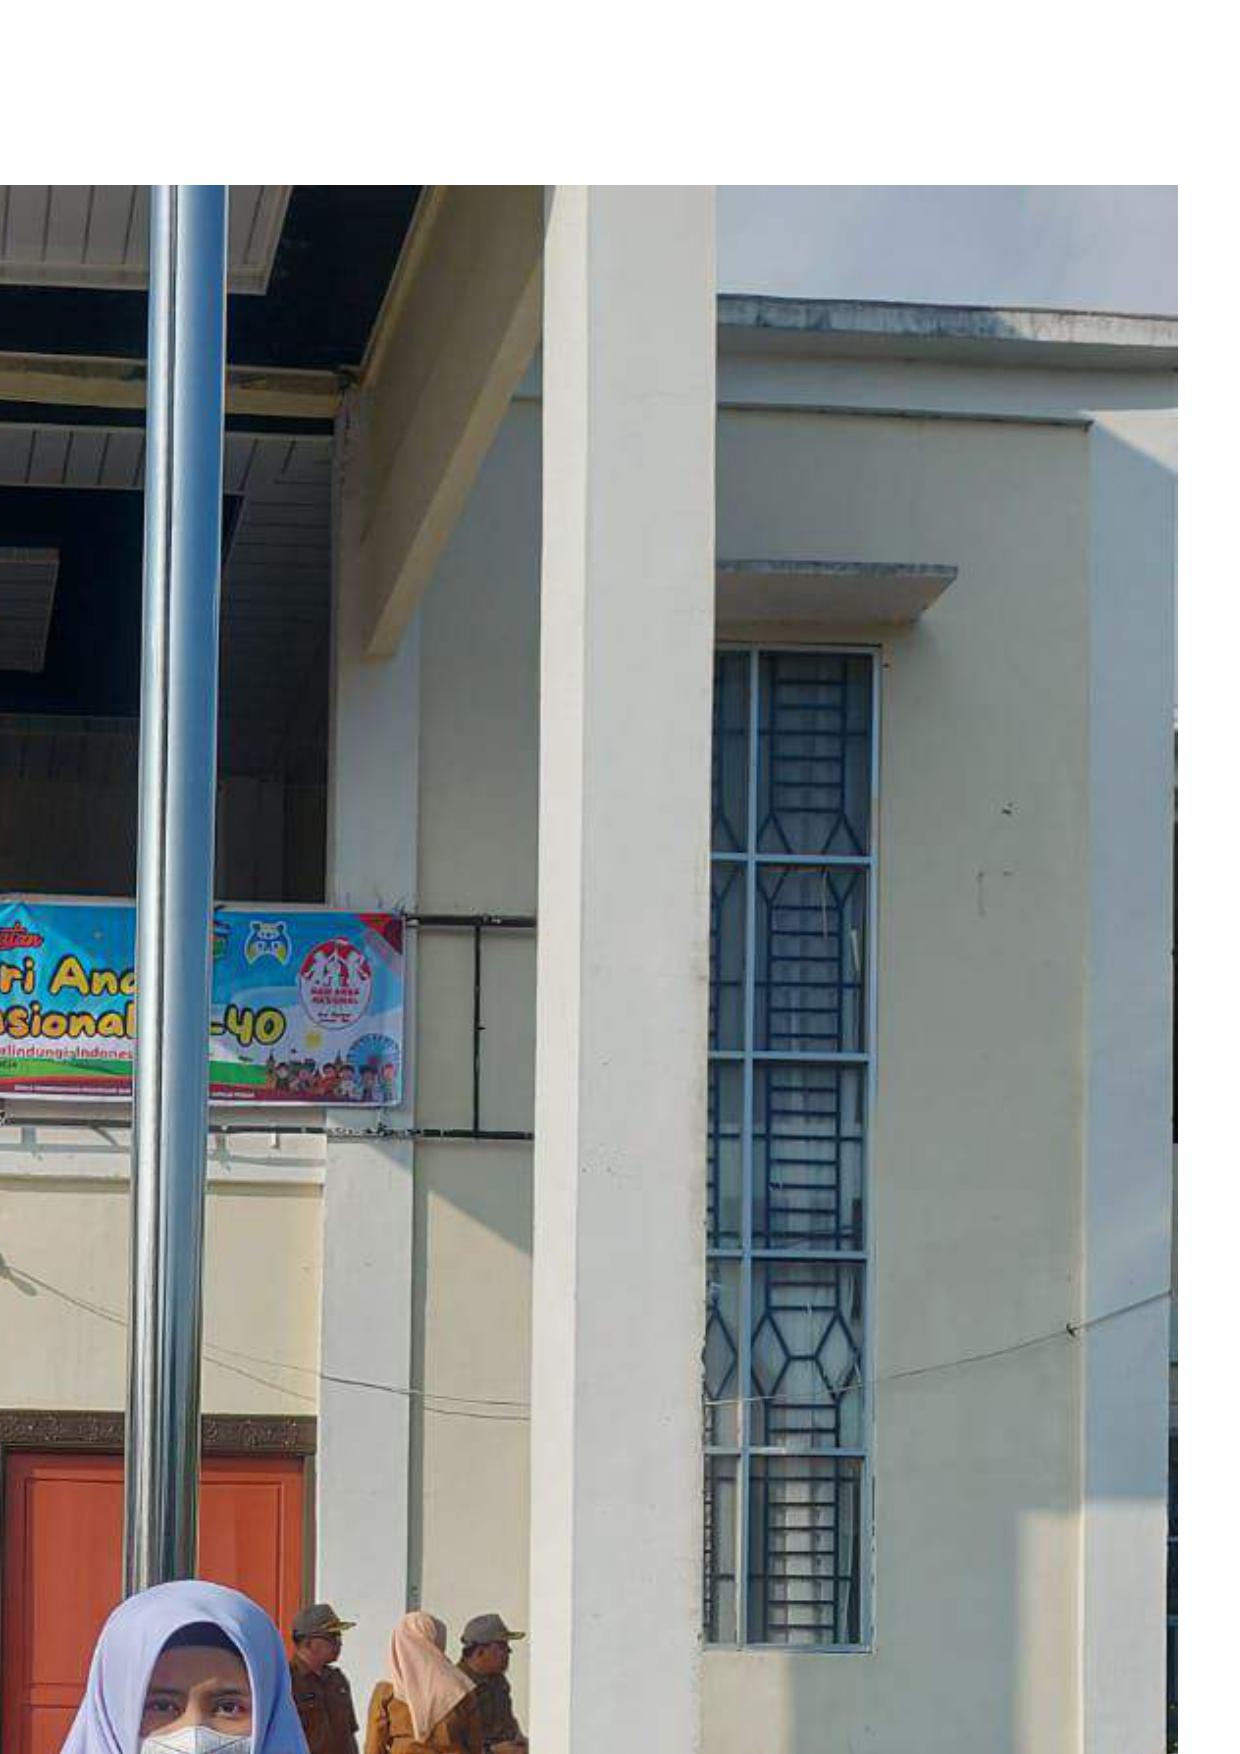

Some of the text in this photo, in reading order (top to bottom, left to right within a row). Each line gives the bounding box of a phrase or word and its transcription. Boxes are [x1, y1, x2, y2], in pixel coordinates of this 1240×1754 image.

[50, 954, 139, 996] Ana
[208, 1003, 287, 1047] -40
[76, 1046, 134, 1059] Indones
